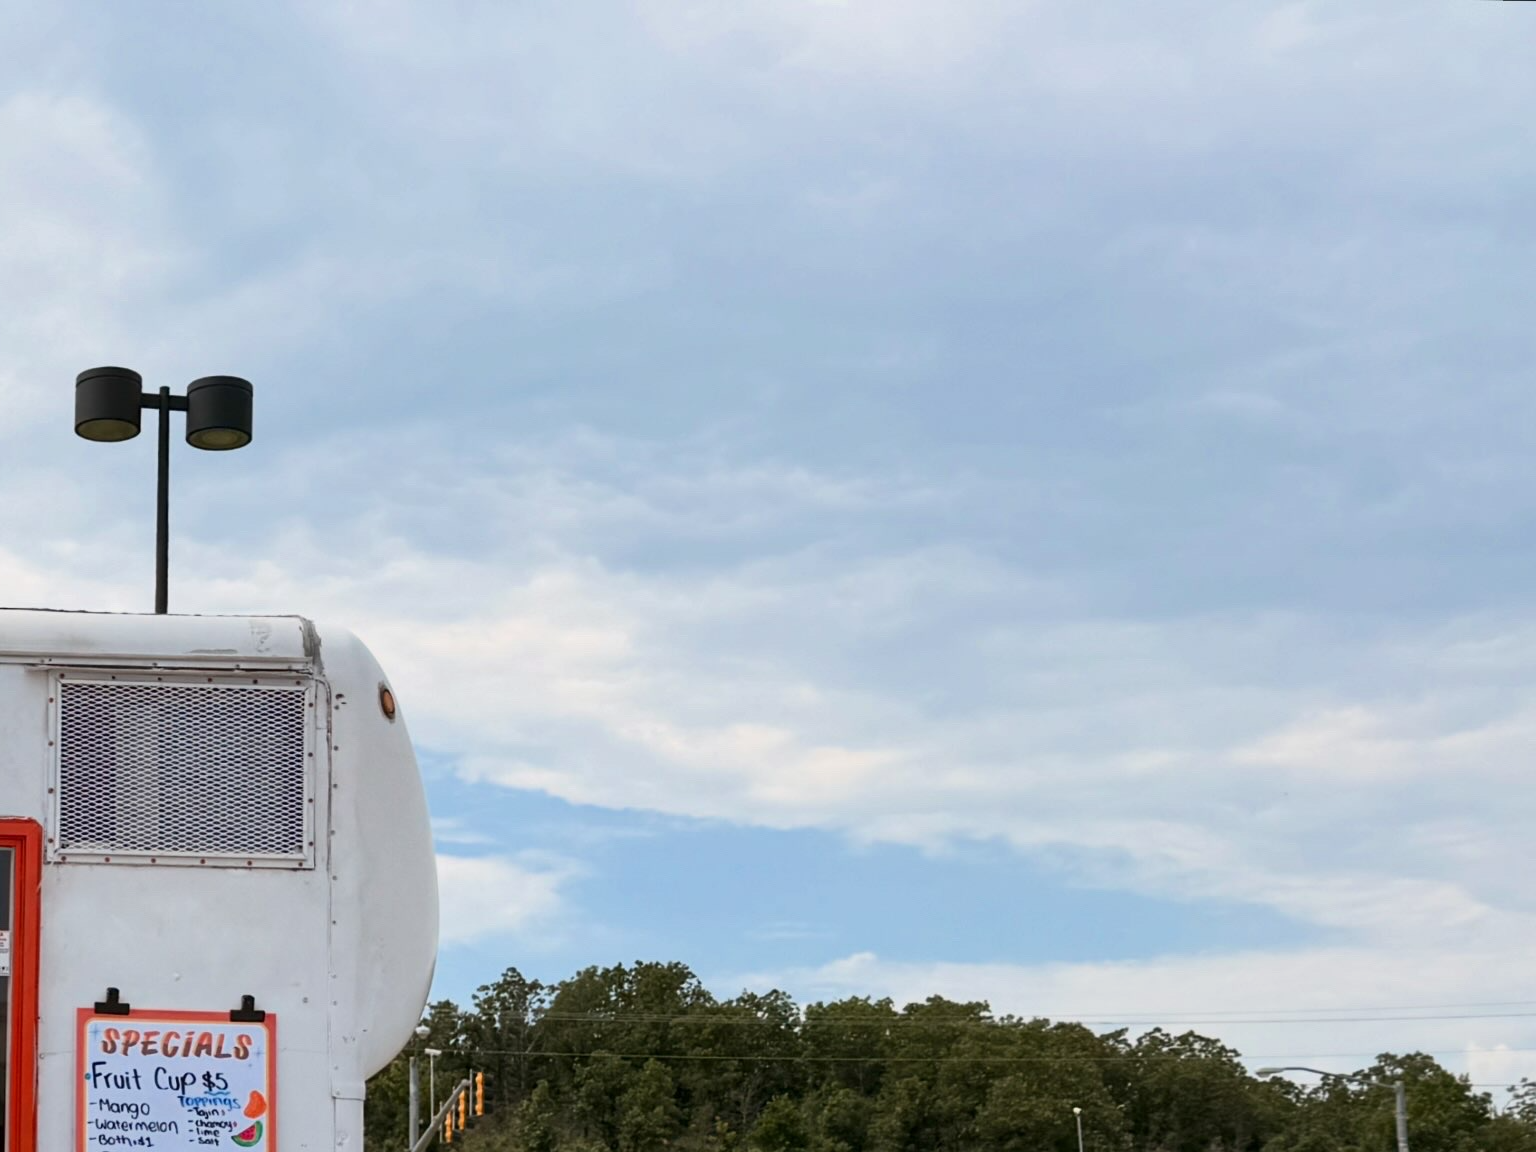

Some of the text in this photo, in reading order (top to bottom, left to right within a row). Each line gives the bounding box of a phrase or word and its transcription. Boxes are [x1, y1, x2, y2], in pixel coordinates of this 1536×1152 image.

[91, 1061, 228, 1095] Fruit Cup $5
